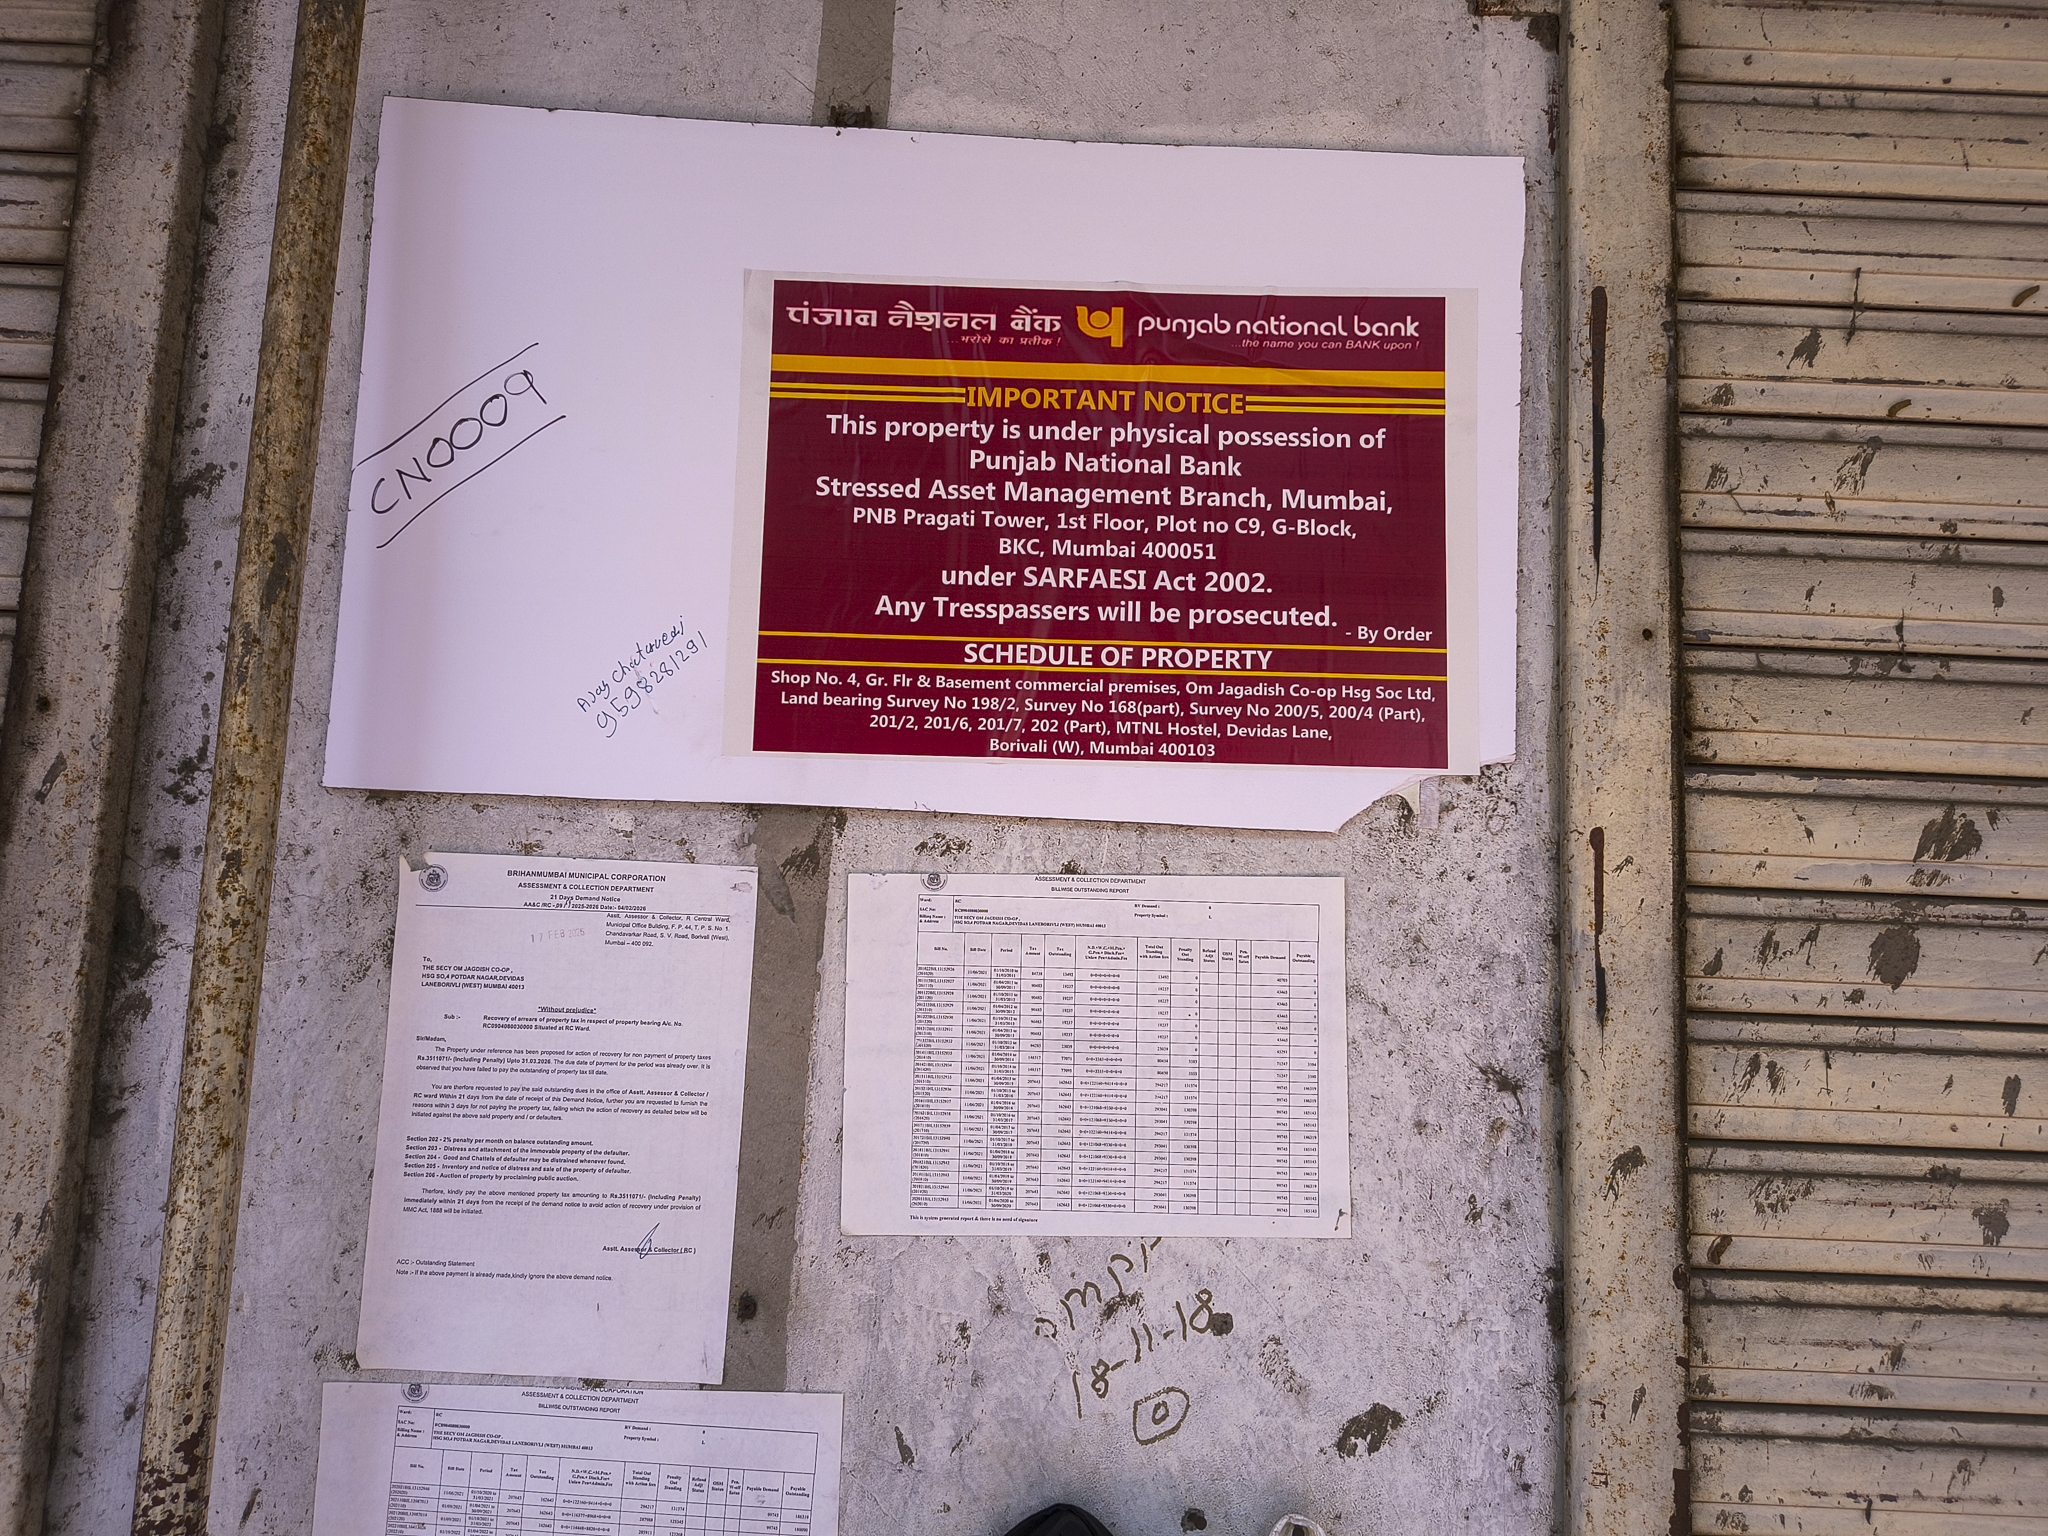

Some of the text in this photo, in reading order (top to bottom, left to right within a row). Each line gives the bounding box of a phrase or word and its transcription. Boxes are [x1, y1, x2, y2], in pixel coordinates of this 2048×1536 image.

[786, 300, 1062, 333] पंजाब नैशनल बैंक
[1138, 313, 1420, 340] punjab national bank
[1262, 340, 1294, 349] name
[1297, 340, 1318, 350] you
[1321, 341, 1342, 350] can
[1345, 340, 1380, 350] BANK
[1383, 342, 1412, 351] upon
[966, 386, 1244, 414] IMPORTANT NOTICE
[825, 413, 1387, 451] This property is under physical possession of
[970, 449, 1242, 477] Punjab National Bank
[815, 475, 1393, 515] Stressed Asset Management Branch, Mumbai,
[853, 506, 1357, 540] PNB Pragati Tower, 1st Floor, Plot no C9, G-Block,
[999, 537, 1217, 560] BKC, Mumbai 400051
[941, 564, 1273, 594] under SARFAESI Act 2002.
[874, 594, 1338, 630] Any Tresspassers will be prosecuted.
[1357, 625, 1379, 644] By
[1383, 626, 1433, 642] Order
[964, 643, 1273, 670] SCHEDULE OF PROPERTY
[771, 669, 1436, 703] Shop No. 4, Gr. Flr & Basement commercial premises, Om Jagadish Co-op Hsg Soc Ltd,
[781, 691, 1426, 724] Land bearing Survey No 198/2, Survey No 168(part), Survey No 200/5, 200/4 (Part),
[869, 714, 1332, 741] 201/2, 201/6, 201/7, 202 (Part), MTNL Hostel, Devidas Lane,
[989, 738, 1216, 757] Borivali (W), Mumbai 400103
[507, 870, 666, 882] BRIHANMUMBAI MUNICIPAL CORPORATION
[518, 882, 562, 890] ASSESSMENT
[568, 884, 610, 892] COLLECTION
[558, 894, 574, 902] Days
[522, 1391, 559, 1399] ASSESSMENT
[565, 1394, 600, 1402] COLLECTION
[601, 1396, 639, 1404] DEPARTMENT
[562, 1404, 598, 1412] OUTSTANDING
[599, 1406, 620, 1414] REPORT
